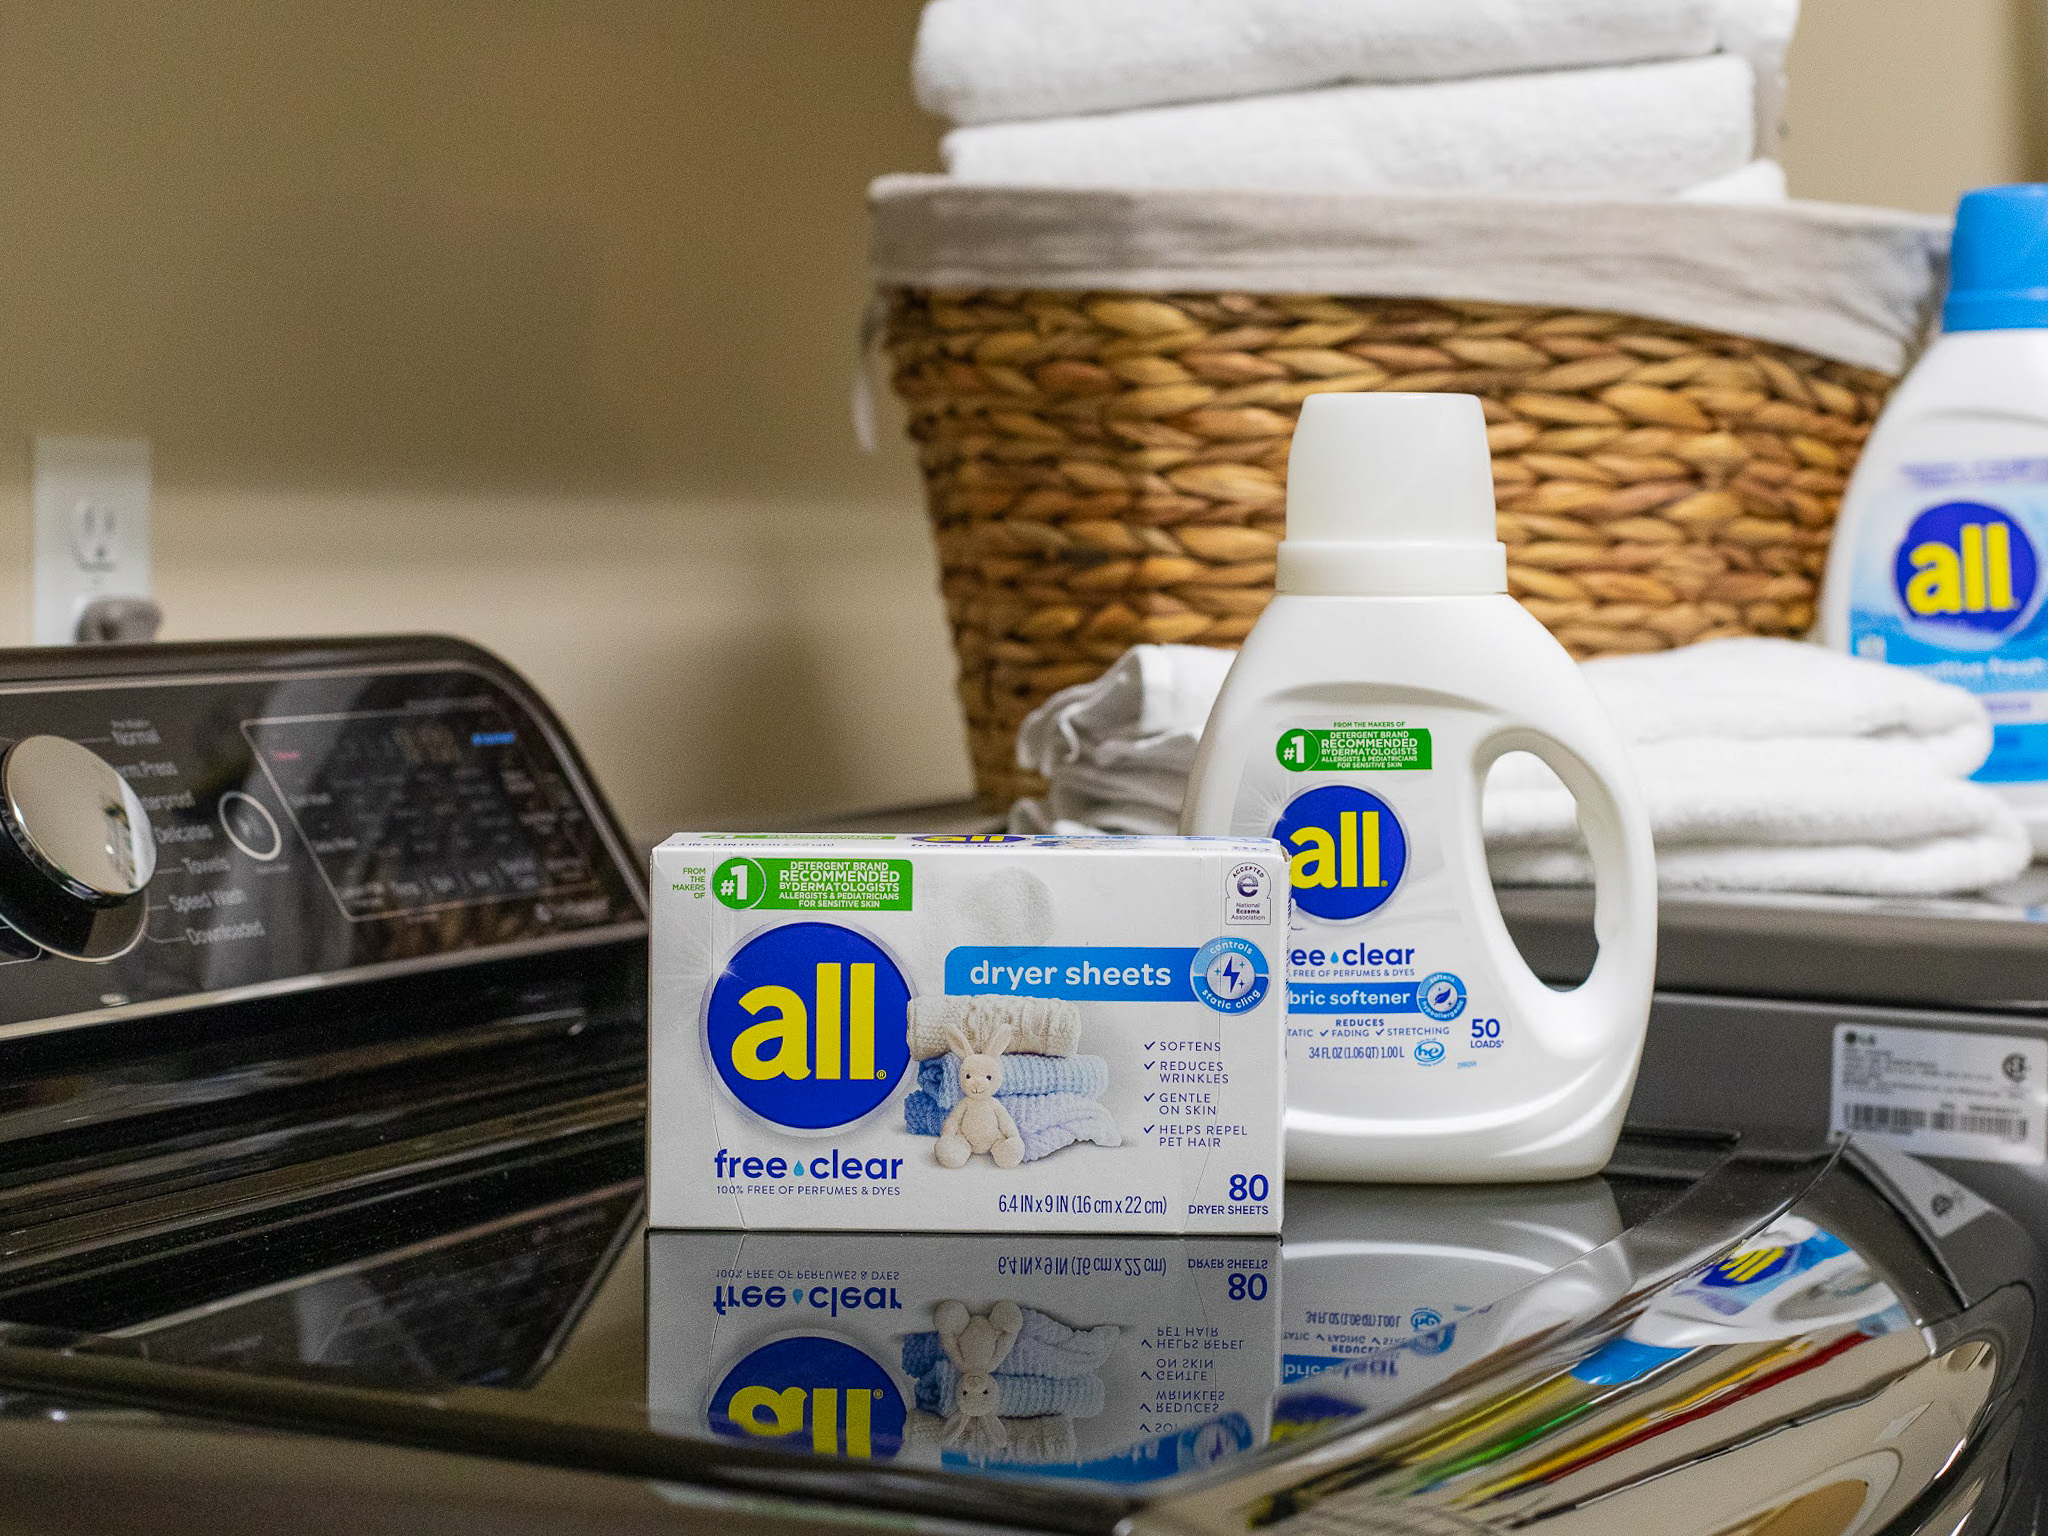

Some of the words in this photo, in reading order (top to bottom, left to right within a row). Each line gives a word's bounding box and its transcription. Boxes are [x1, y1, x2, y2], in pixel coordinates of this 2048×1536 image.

[1906, 522, 2011, 615] all
[1330, 731, 1378, 739] DETERGENT
[1321, 738, 1417, 748] RECOMMENDED
[1284, 735, 1305, 763] #1
[1331, 748, 1417, 756] DERMATOLOGISTS
[1290, 811, 1380, 889] all
[683, 867, 706, 875] FROM
[790, 861, 850, 871] DETERGENT
[853, 862, 889, 871] BRAND
[779, 870, 900, 882] RECOMMENDED
[1232, 866, 1265, 878] ACCEPTED
[720, 865, 748, 900] #1
[779, 882, 791, 890] BY
[792, 881, 900, 892] DERMATOLOGISTS
[779, 892, 827, 900] ALLERGISTS
[829, 892, 836, 900] &
[837, 892, 900, 901] PEDIATRICIANS
[799, 900, 815, 908] FOR
[817, 900, 859, 908] SENSITIVE
[860, 900, 880, 908] SKIN
[1210, 941, 1253, 955] controls
[1290, 948, 1325, 966] ee
[1342, 942, 1415, 966] clear
[970, 960, 1058, 991] dryer
[1065, 961, 1172, 986] sheets
[1293, 969, 1315, 977] FREE
[1318, 969, 1331, 977] OF
[1334, 969, 1382, 977] PERFUMES
[1384, 969, 1390, 977] &
[1392, 969, 1415, 977] DYES
[1202, 989, 1232, 1009] static
[1235, 989, 1261, 1009] cling
[1289, 990, 1326, 1006] bric
[1330, 990, 1411, 1006] softener
[731, 962, 875, 1081] all
[1336, 1019, 1384, 1027] REDUCES
[1288, 1029, 1314, 1037] TATIC
[1331, 1029, 1369, 1037] FADING
[1388, 1027, 1450, 1036] STRETCHING
[1471, 1019, 1500, 1038] 50
[1160, 1041, 1221, 1051] SOFTENS
[1418, 1044, 1439, 1058] he
[1309, 1046, 1320, 1059] 34
[1322, 1046, 1331, 1059] FL
[1333, 1046, 1343, 1059] OZ
[1344, 1046, 1364, 1059] (1.06
[1365, 1046, 1379, 1059] QT)
[1381, 1046, 1399, 1059] 1.00
[1399, 1046, 1405, 1058] L
[1160, 1061, 1223, 1071] REDUCES
[1160, 1073, 1229, 1084] WRINKLES
[1159, 1093, 1211, 1103] GENTLE
[1159, 1106, 1180, 1115] ON
[1186, 1106, 1217, 1115] SKIN
[1159, 1125, 1201, 1135] HELPS
[1206, 1126, 1248, 1136] REPEL
[1159, 1137, 1182, 1147] PET
[1188, 1138, 1221, 1148] HAIR
[714, 1149, 787, 1179] free
[809, 1149, 903, 1180] clear
[716, 1185, 744, 1195] 100%
[747, 1185, 775, 1194] FREE
[778, 1185, 794, 1195] OF
[797, 1186, 858, 1195] PERFUMES
[861, 1186, 869, 1195] &
[872, 1186, 901, 1196] DYES
[1229, 1174, 1269, 1202] 80
[998, 1194, 1018, 1213] 6.4
[1020, 1195, 1034, 1213] IN
[1035, 1200, 1042, 1213] x
[1045, 1195, 1053, 1213] 9
[1056, 1195, 1068, 1213] IN
[1072, 1195, 1091, 1214] (16
[1094, 1200, 1113, 1214] cm
[1115, 1201, 1123, 1214] x
[1125, 1196, 1142, 1214] 22
[1144, 1195, 1167, 1215] cm)
[1189, 1205, 1225, 1215] DRYER
[1228, 1205, 1269, 1215] SHEETS
